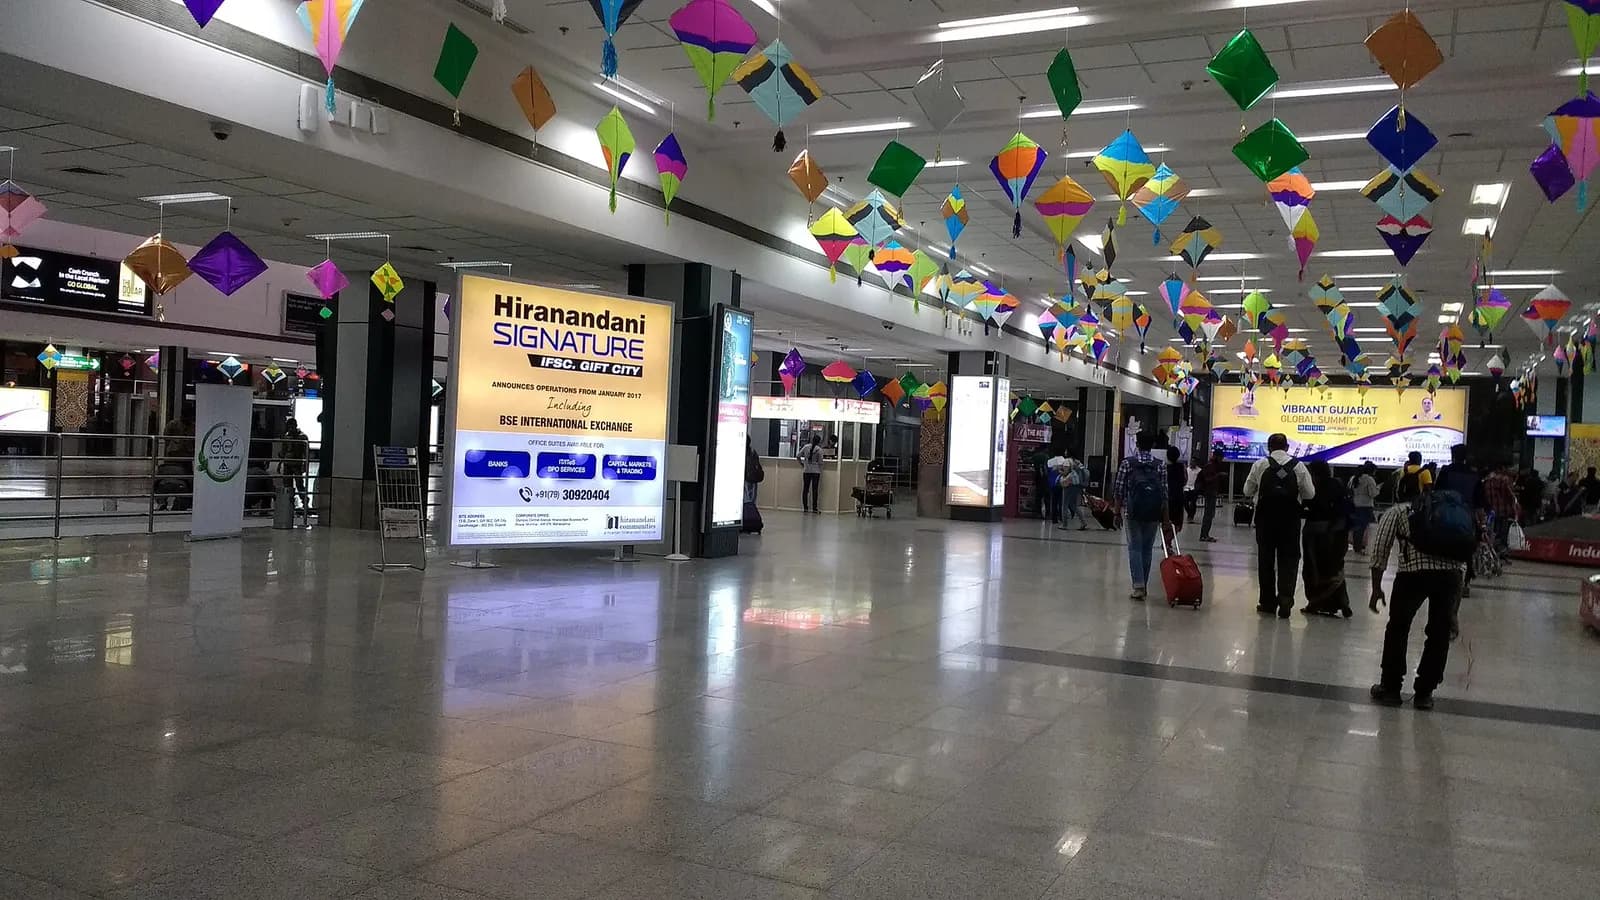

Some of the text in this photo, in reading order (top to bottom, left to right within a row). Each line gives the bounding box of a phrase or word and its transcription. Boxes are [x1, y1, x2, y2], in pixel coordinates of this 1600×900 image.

[68, 267, 100, 278] Cash Crunch
[74, 274, 88, 282] Local
[67, 280, 76, 288] GO
[494, 294, 646, 335] Hiranandani
[493, 322, 644, 361] SIGNATURE
[540, 357, 641, 376] IFSC. GIFT CITY
[491, 381, 535, 391] ANNOUNCES
[536, 384, 578, 394] OPERATIONS
[578, 388, 597, 396] FROM
[597, 389, 626, 398] JANUARY
[546, 396, 592, 417] Including
[1281, 404, 1378, 416] VIBRANT GUJARAT
[499, 415, 633, 432] BSE INTERNATIONAL EXCHANGE
[1280, 414, 1377, 425] GLOBAL SUMMIT 2017
[528, 439, 547, 447] OFFICE
[547, 440, 567, 448] SUITES
[487, 460, 508, 468] BANKS
[607, 460, 652, 468] CAPITAL MARKETS
[547, 466, 586, 474] BPO SERVICES
[621, 467, 643, 475] TRADING
[562, 489, 610, 501] 30920404
